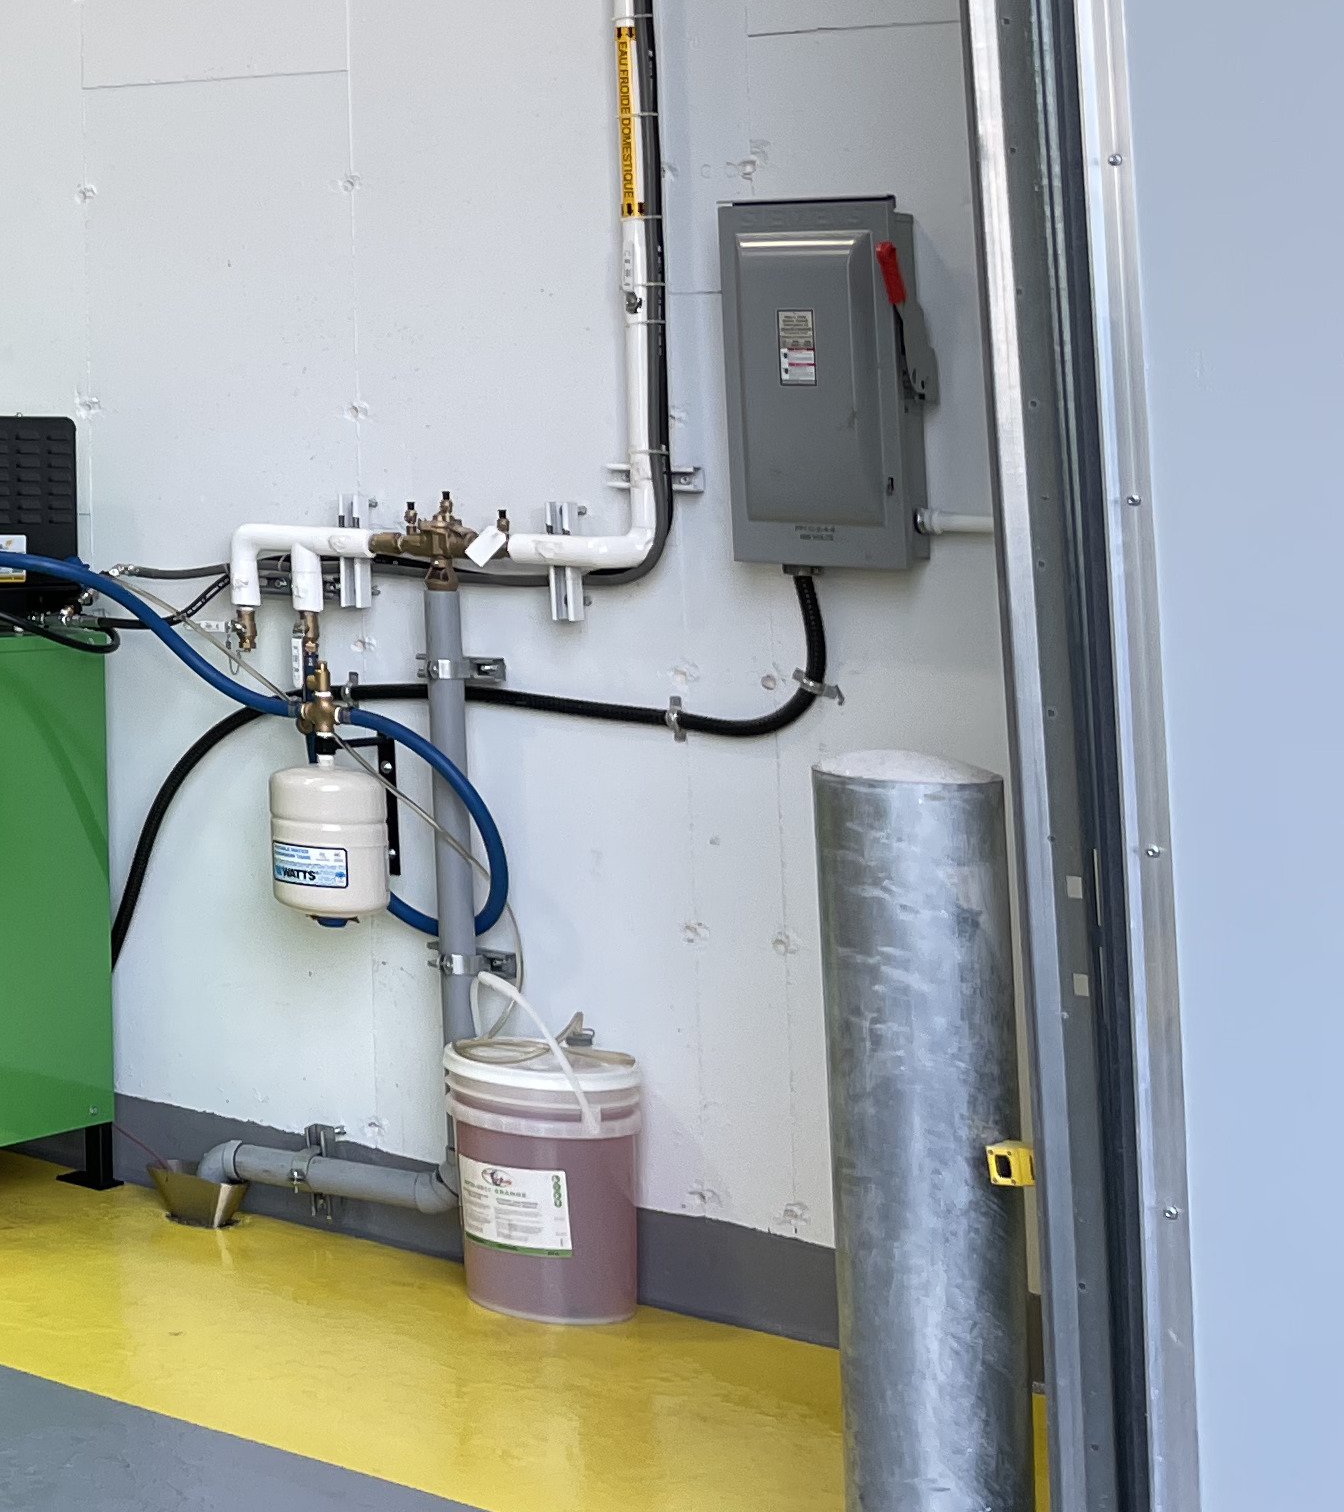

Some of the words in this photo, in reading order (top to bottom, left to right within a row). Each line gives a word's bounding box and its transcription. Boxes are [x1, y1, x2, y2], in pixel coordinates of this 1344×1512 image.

[618, 41, 628, 66] EAU
[619, 69, 631, 115] FROIDE
[621, 117, 634, 199] DOMESTIQUE
[282, 867, 316, 881] WATTS
